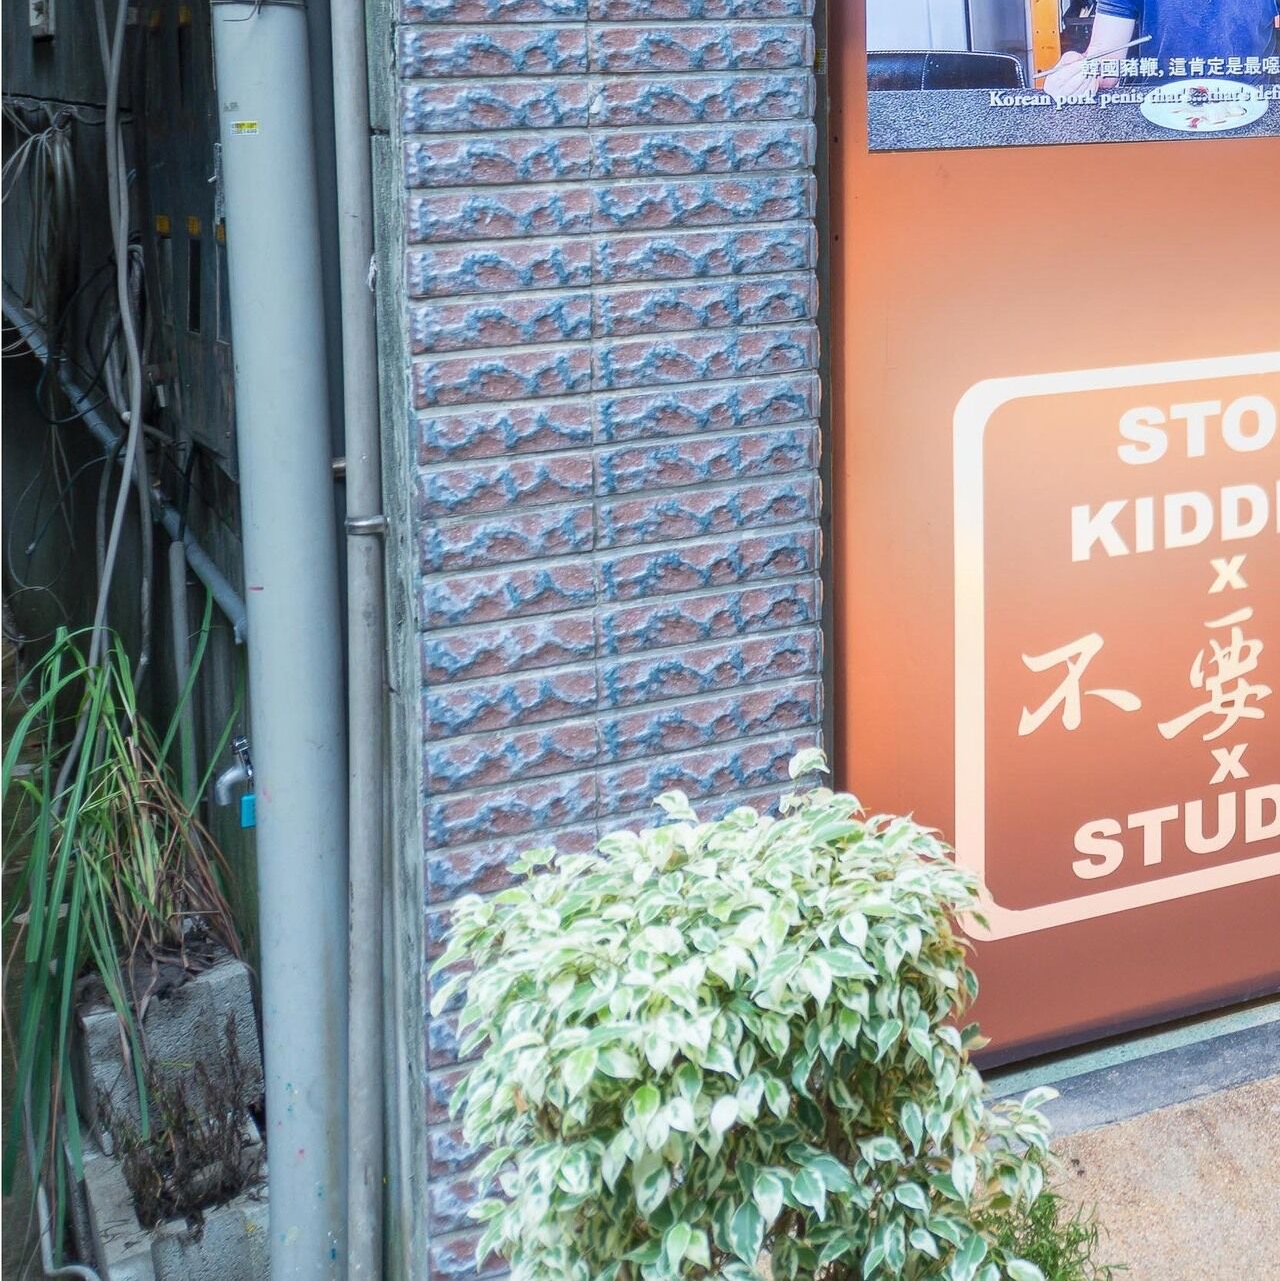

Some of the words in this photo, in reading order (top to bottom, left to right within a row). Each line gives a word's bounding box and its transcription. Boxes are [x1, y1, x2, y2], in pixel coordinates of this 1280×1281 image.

[989, 90, 1052, 107] Korean
[1055, 89, 1098, 110] pork
[1101, 89, 1146, 109] penis
